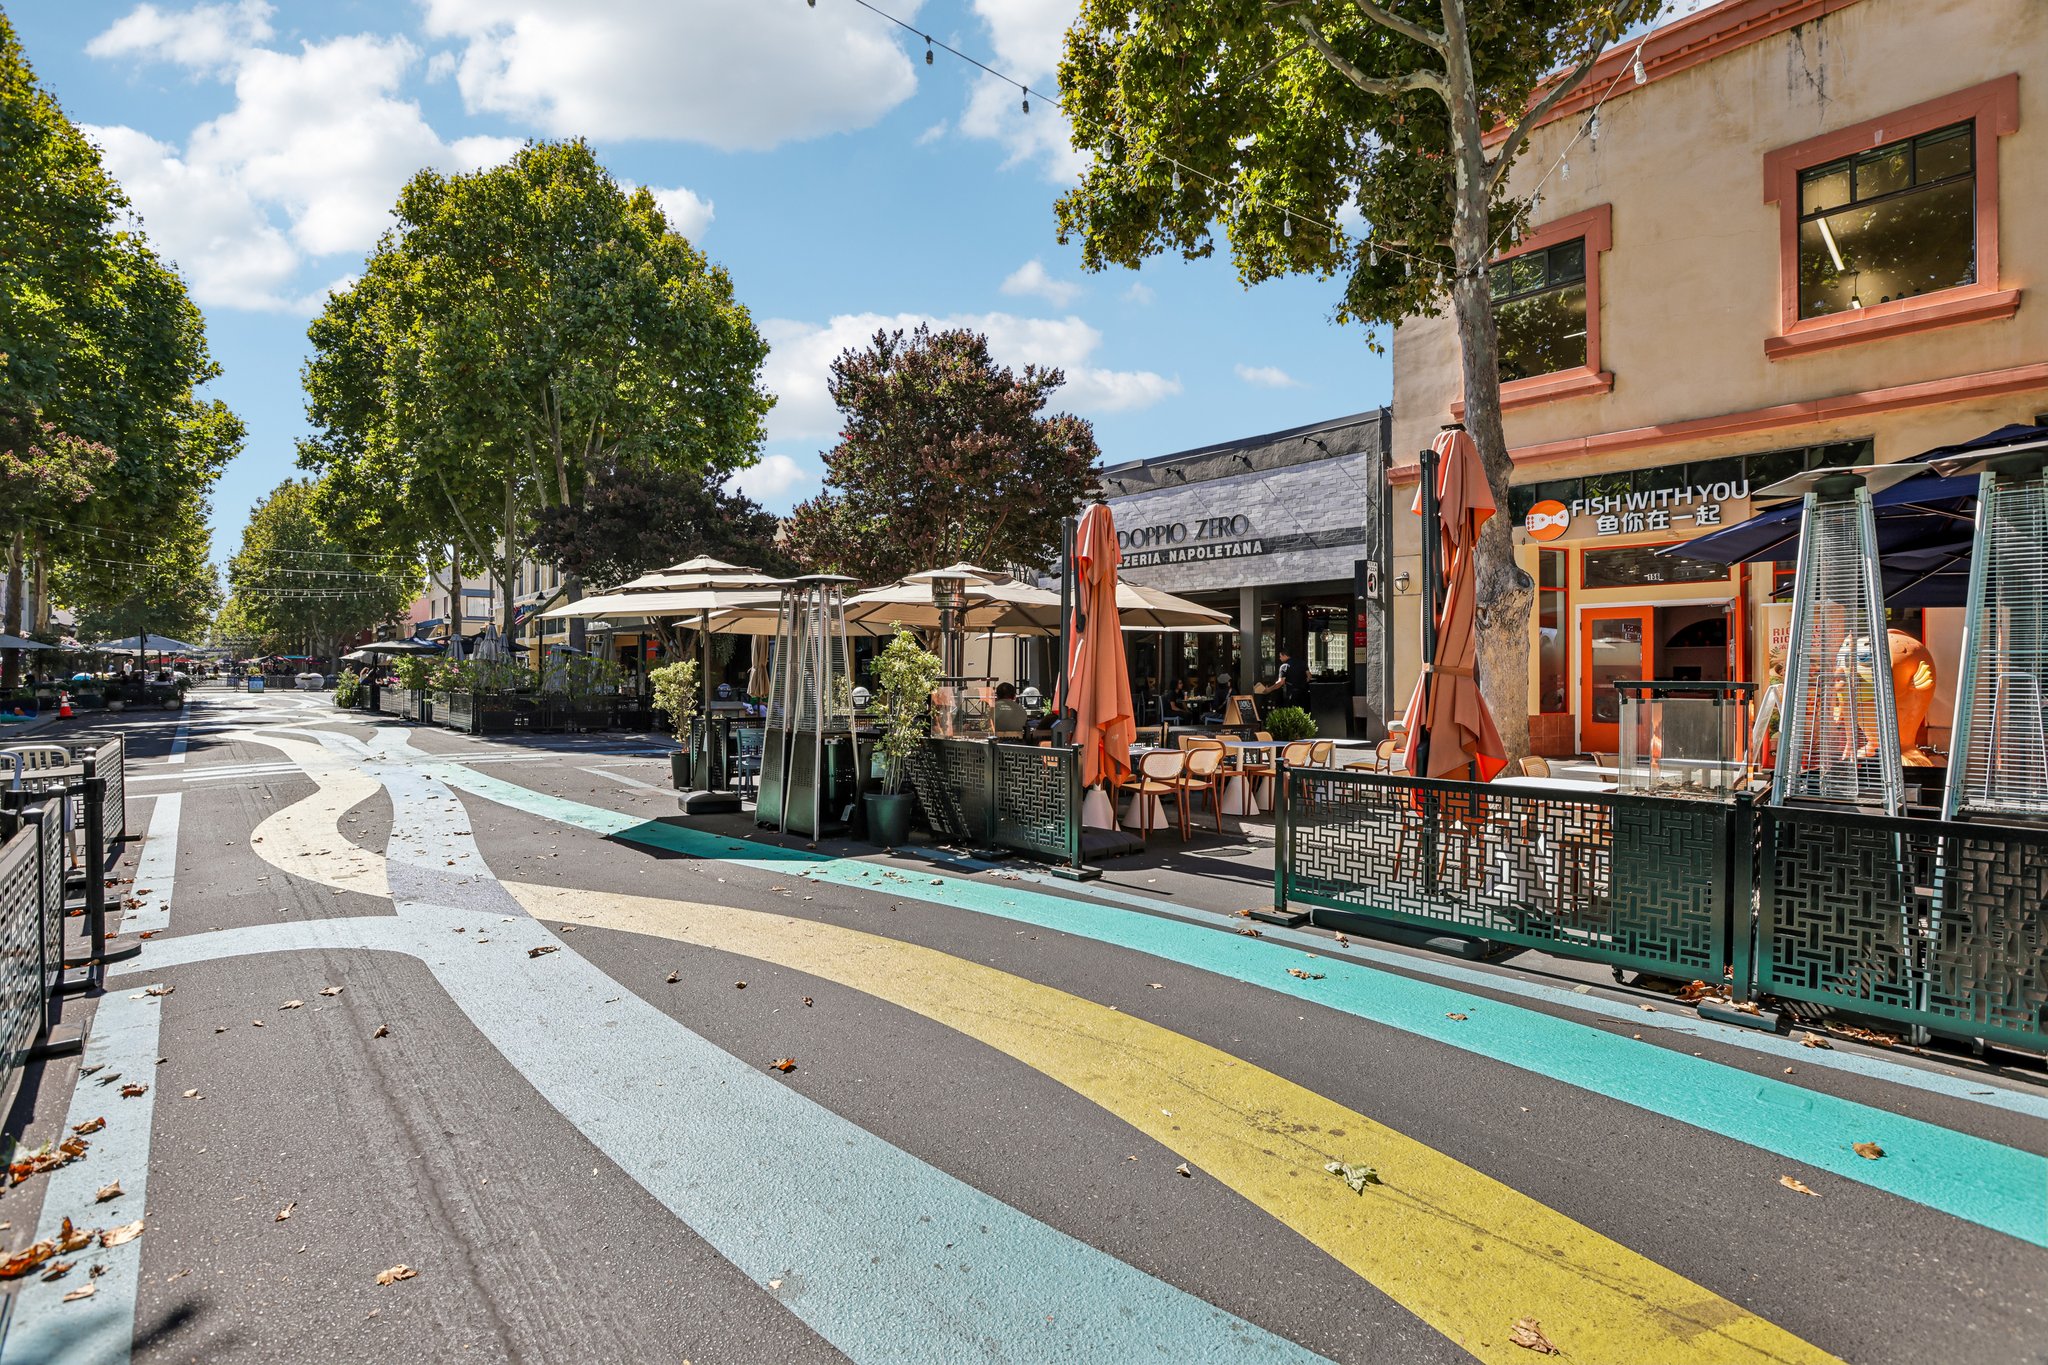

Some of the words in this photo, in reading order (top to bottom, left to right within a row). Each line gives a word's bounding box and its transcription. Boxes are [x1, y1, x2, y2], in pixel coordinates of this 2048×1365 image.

[1572, 494, 1621, 517] FISH
[1625, 486, 1692, 511] WITH
[1696, 479, 1749, 503] YOU
[1117, 522, 1187, 550] DOPPIO
[1194, 513, 1250, 541] ZERO
[1596, 504, 1721, 536] 鱼你在一起
[1117, 551, 1161, 568] ZERIA
[1169, 540, 1263, 563] NAPOLETANA
